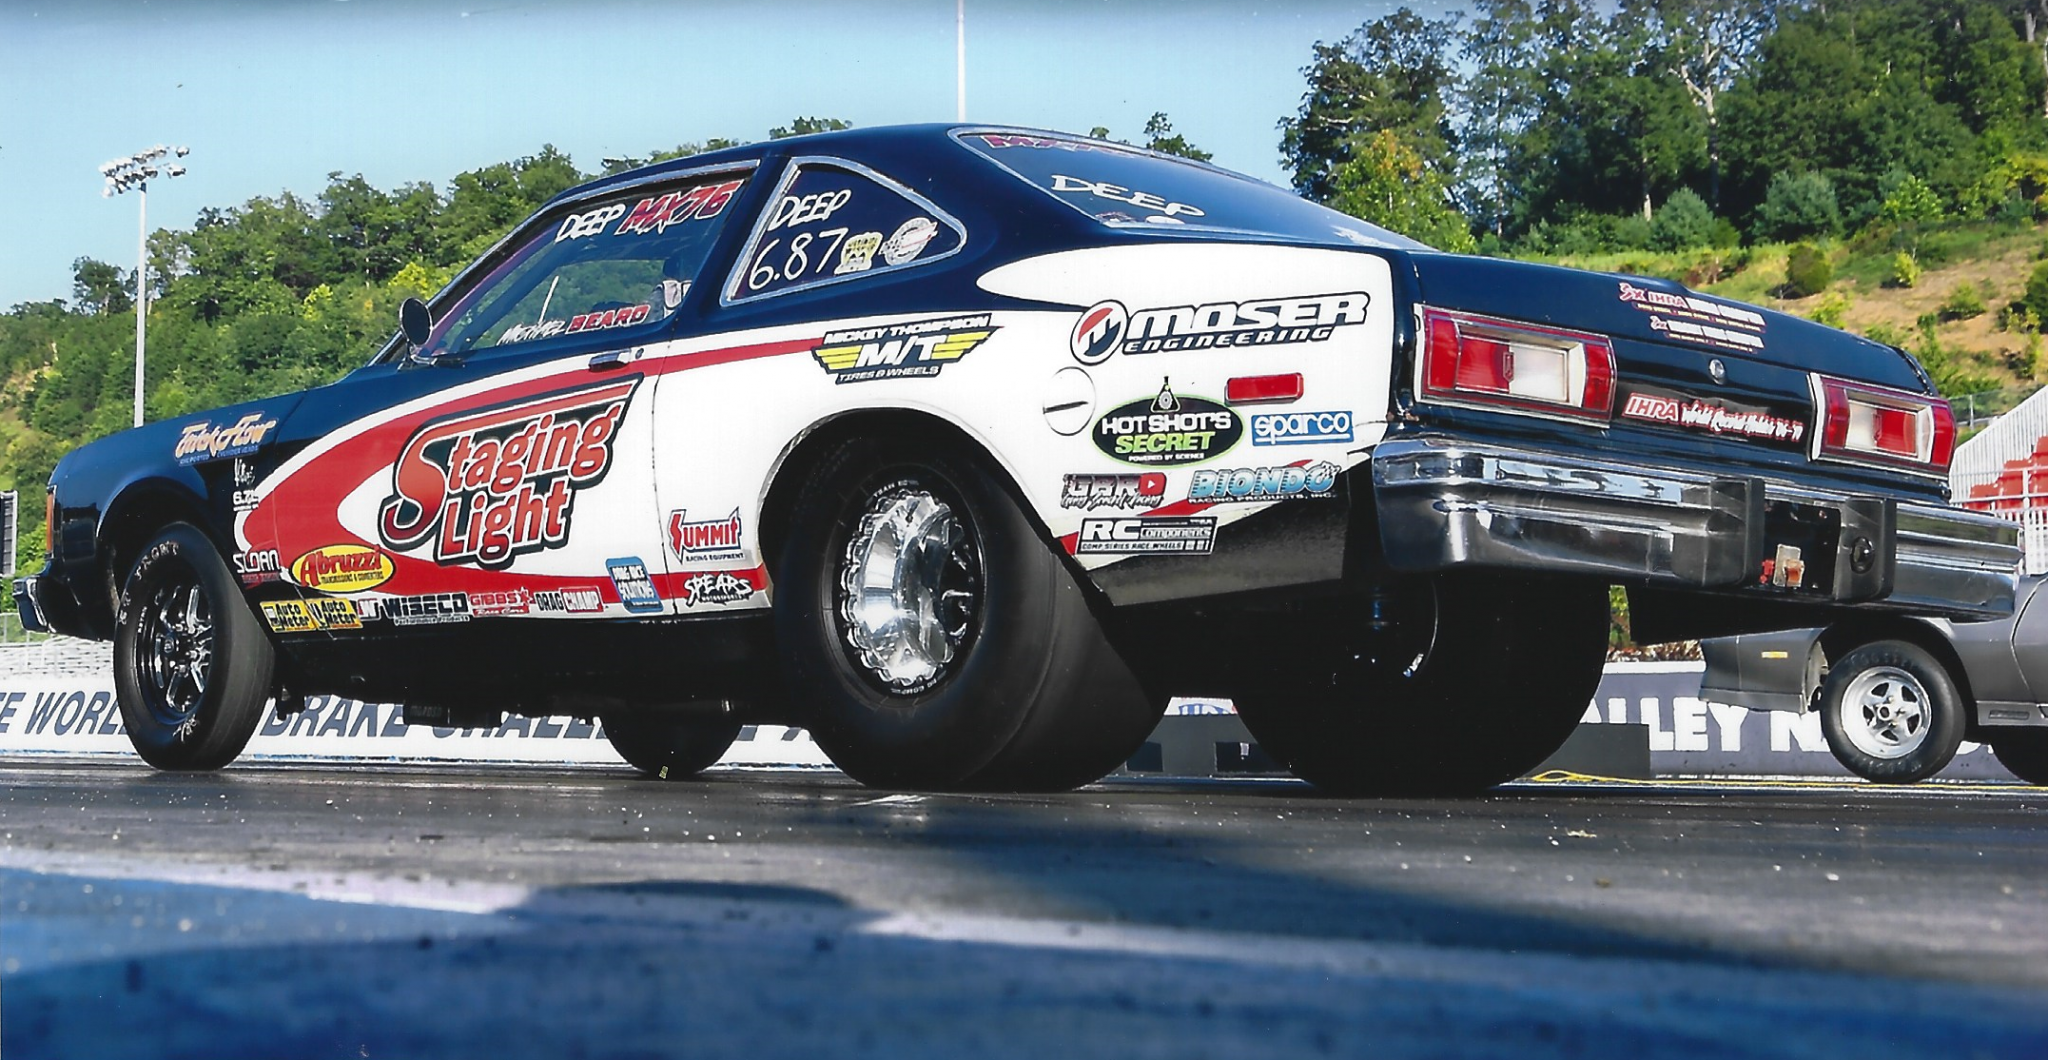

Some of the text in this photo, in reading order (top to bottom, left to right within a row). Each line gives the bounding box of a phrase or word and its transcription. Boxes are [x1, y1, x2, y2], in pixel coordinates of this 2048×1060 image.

[767, 189, 852, 232] DEEP
[1051, 174, 1206, 217] DEEP
[554, 203, 627, 243] DEEP
[749, 228, 849, 290] 6.87
[565, 304, 651, 335] BEARD
[824, 316, 990, 345] MICKEY THOMPSON
[1126, 299, 1366, 340] MOSER
[854, 335, 948, 368] M/T
[1124, 327, 1334, 352] ENGINEERING
[839, 371, 875, 381] TIRES
[886, 366, 940, 377] WHEELS
[1101, 411, 1232, 435] HOT SHOT'S
[1624, 396, 1680, 422] IHRA
[1115, 431, 1216, 454] SECRET
[1254, 412, 1350, 444] sparco
[380, 380, 641, 548] Staging
[1175, 453, 1205, 461] SCIENCE
[1189, 463, 1342, 498] BIONDO
[436, 477, 570, 561] Light
[1081, 520, 1141, 541] RC
[669, 513, 739, 556] SUMMIT
[233, 549, 281, 573] SLOAN
[300, 544, 382, 587] Abruzzi
[470, 593, 517, 605] GIBBS
[535, 590, 600, 611] DRAG CHAMP
[684, 573, 753, 607] SPEARS
[275, 604, 301, 616] Auto
[320, 600, 347, 613] Auto
[323, 613, 356, 629] Meter
[279, 615, 309, 630] Meter
[24, 690, 129, 736] WORL
